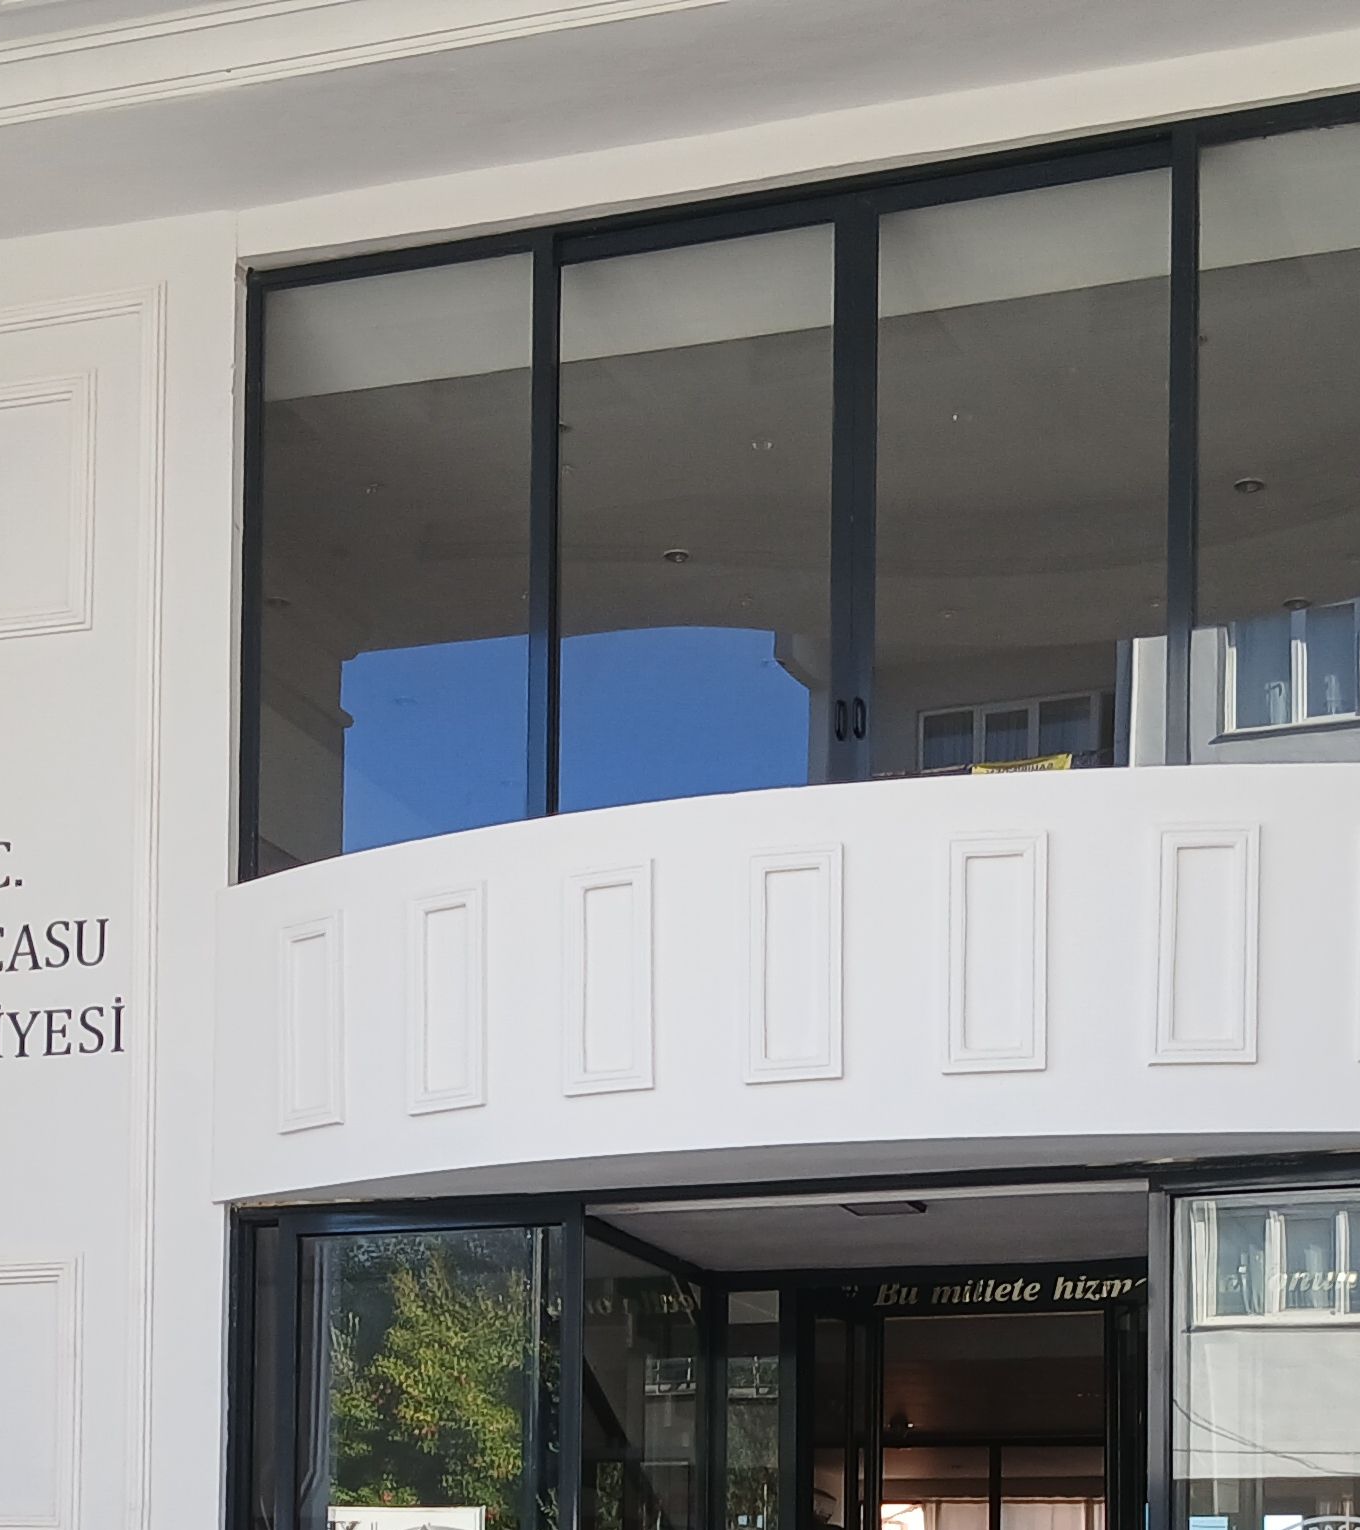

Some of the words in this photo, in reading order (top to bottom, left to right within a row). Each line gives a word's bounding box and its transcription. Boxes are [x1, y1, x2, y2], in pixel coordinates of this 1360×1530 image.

[874, 1282, 920, 1306] Bu
[930, 1277, 1042, 1304] millete
[1052, 1274, 1148, 1302] hizm
